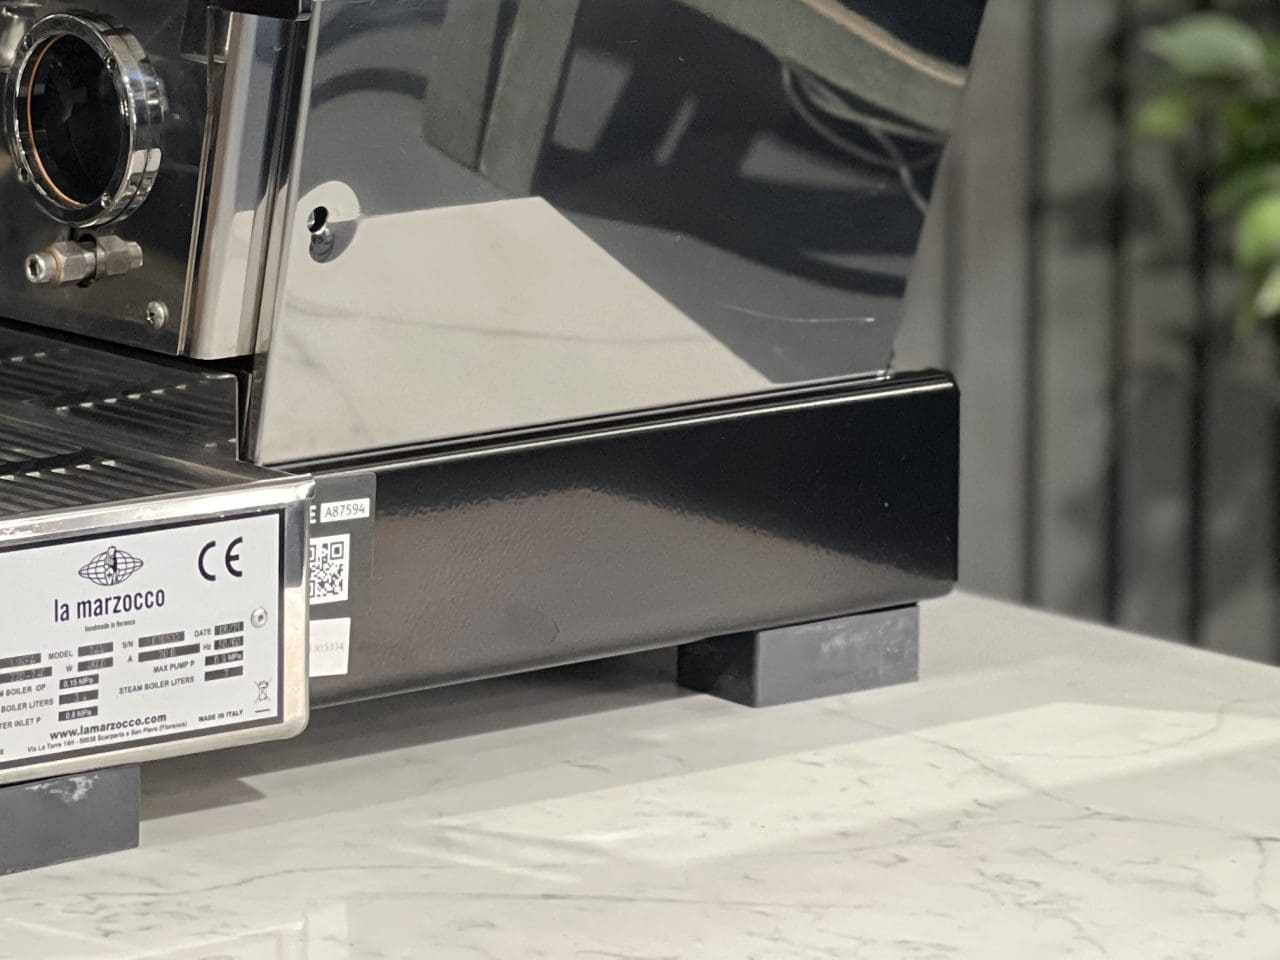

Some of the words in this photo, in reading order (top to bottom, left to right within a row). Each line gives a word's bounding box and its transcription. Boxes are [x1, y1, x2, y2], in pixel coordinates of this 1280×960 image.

[324, 503, 365, 518] A87594
[198, 536, 243, 581] CE
[54, 598, 70, 622] la
[77, 589, 165, 619] marzocco
[194, 628, 212, 638] DATE
[203, 643, 212, 651] Hz
[48, 650, 73, 660] MODEL
[127, 655, 133, 663] A
[65, 664, 73, 672] W
[153, 664, 168, 673] MAX
[169, 661, 189, 671] PUMP
[6, 686, 33, 697] BOILER
[35, 683, 47, 691] OP
[79, 676, 94, 686] MPa
[119, 684, 143, 694] STEAM
[144, 680, 170, 690] BOILER
[171, 676, 195, 686] LITERS
[1, 702, 28, 714] BOILER
[29, 698, 54, 709] LITERS
[198, 713, 217, 722] MADE
[226, 709, 244, 718] ITALY
[14, 718, 35, 728] INLET
[36, 716, 42, 725] P
[50, 714, 167, 740] www.lamarzocco.com
[47, 742, 62, 750] Torre
